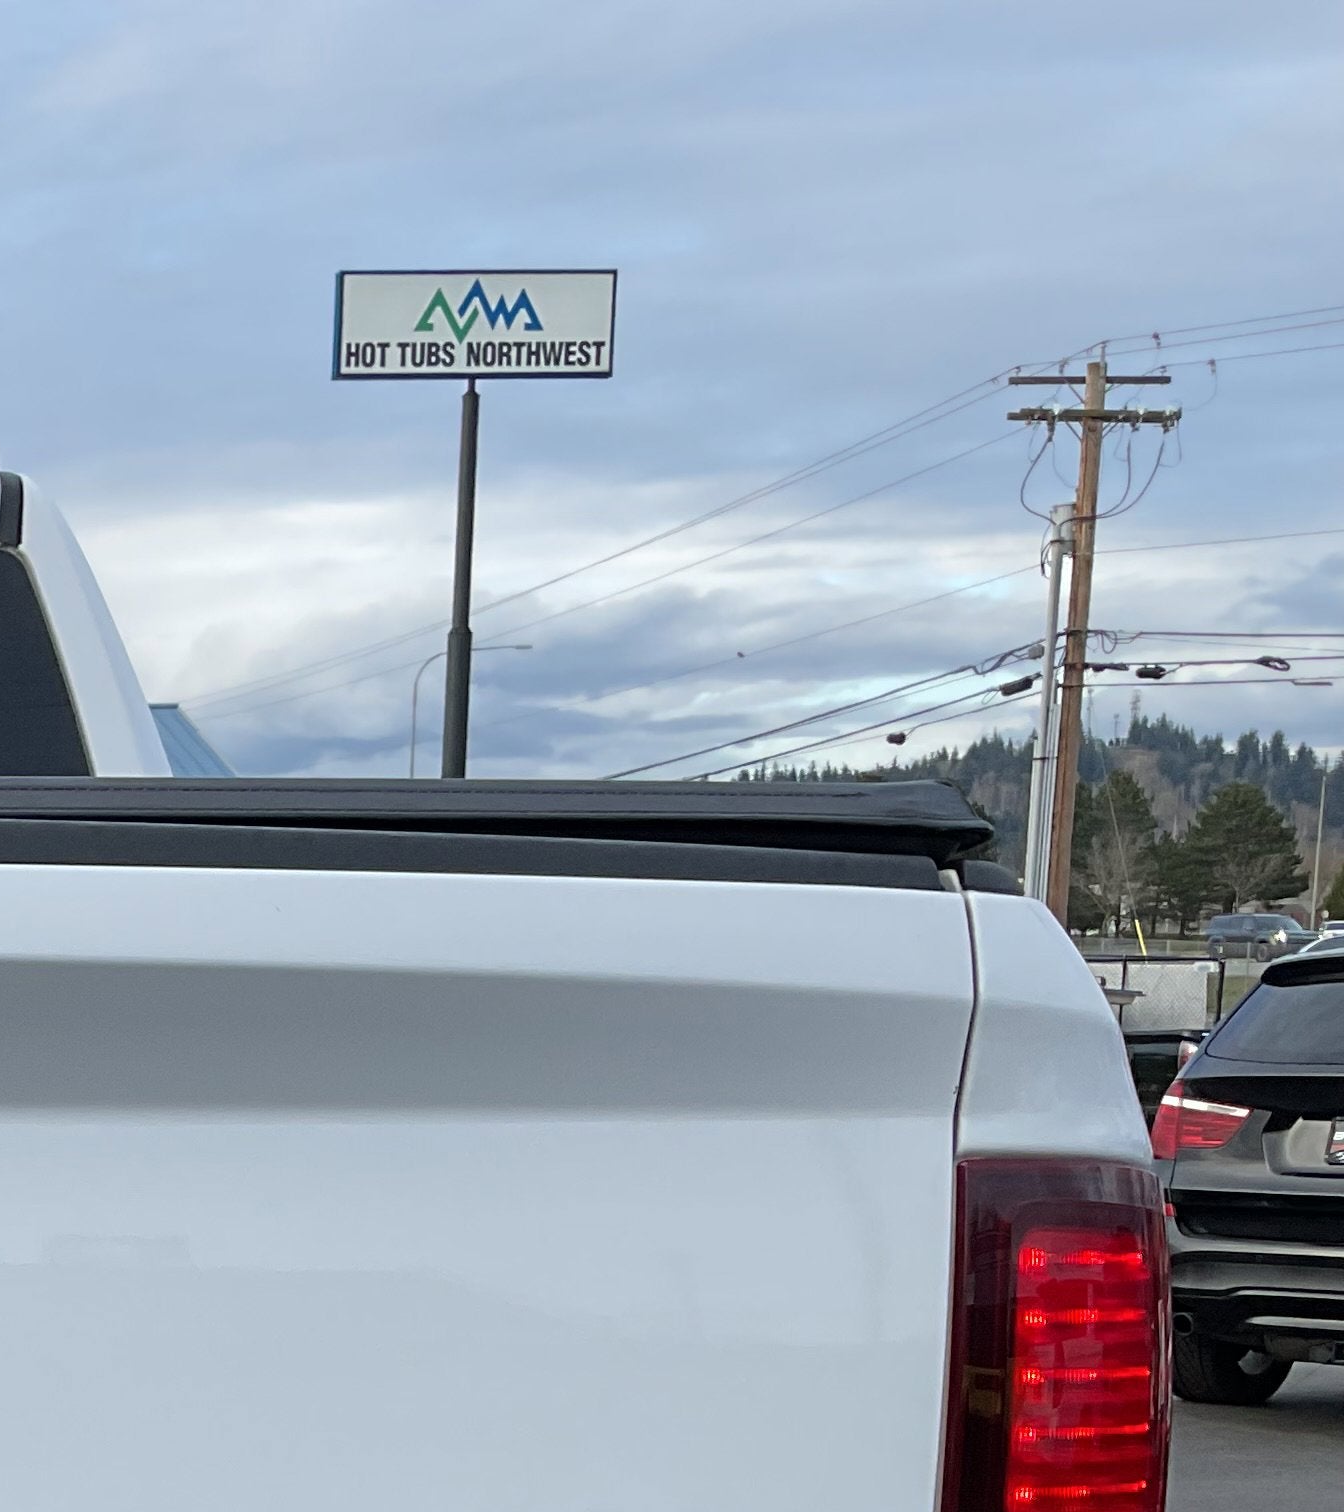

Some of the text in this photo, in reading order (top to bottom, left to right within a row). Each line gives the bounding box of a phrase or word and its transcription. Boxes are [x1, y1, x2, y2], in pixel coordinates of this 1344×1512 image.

[345, 340, 606, 368] HOT TUBS NORTHWEST
